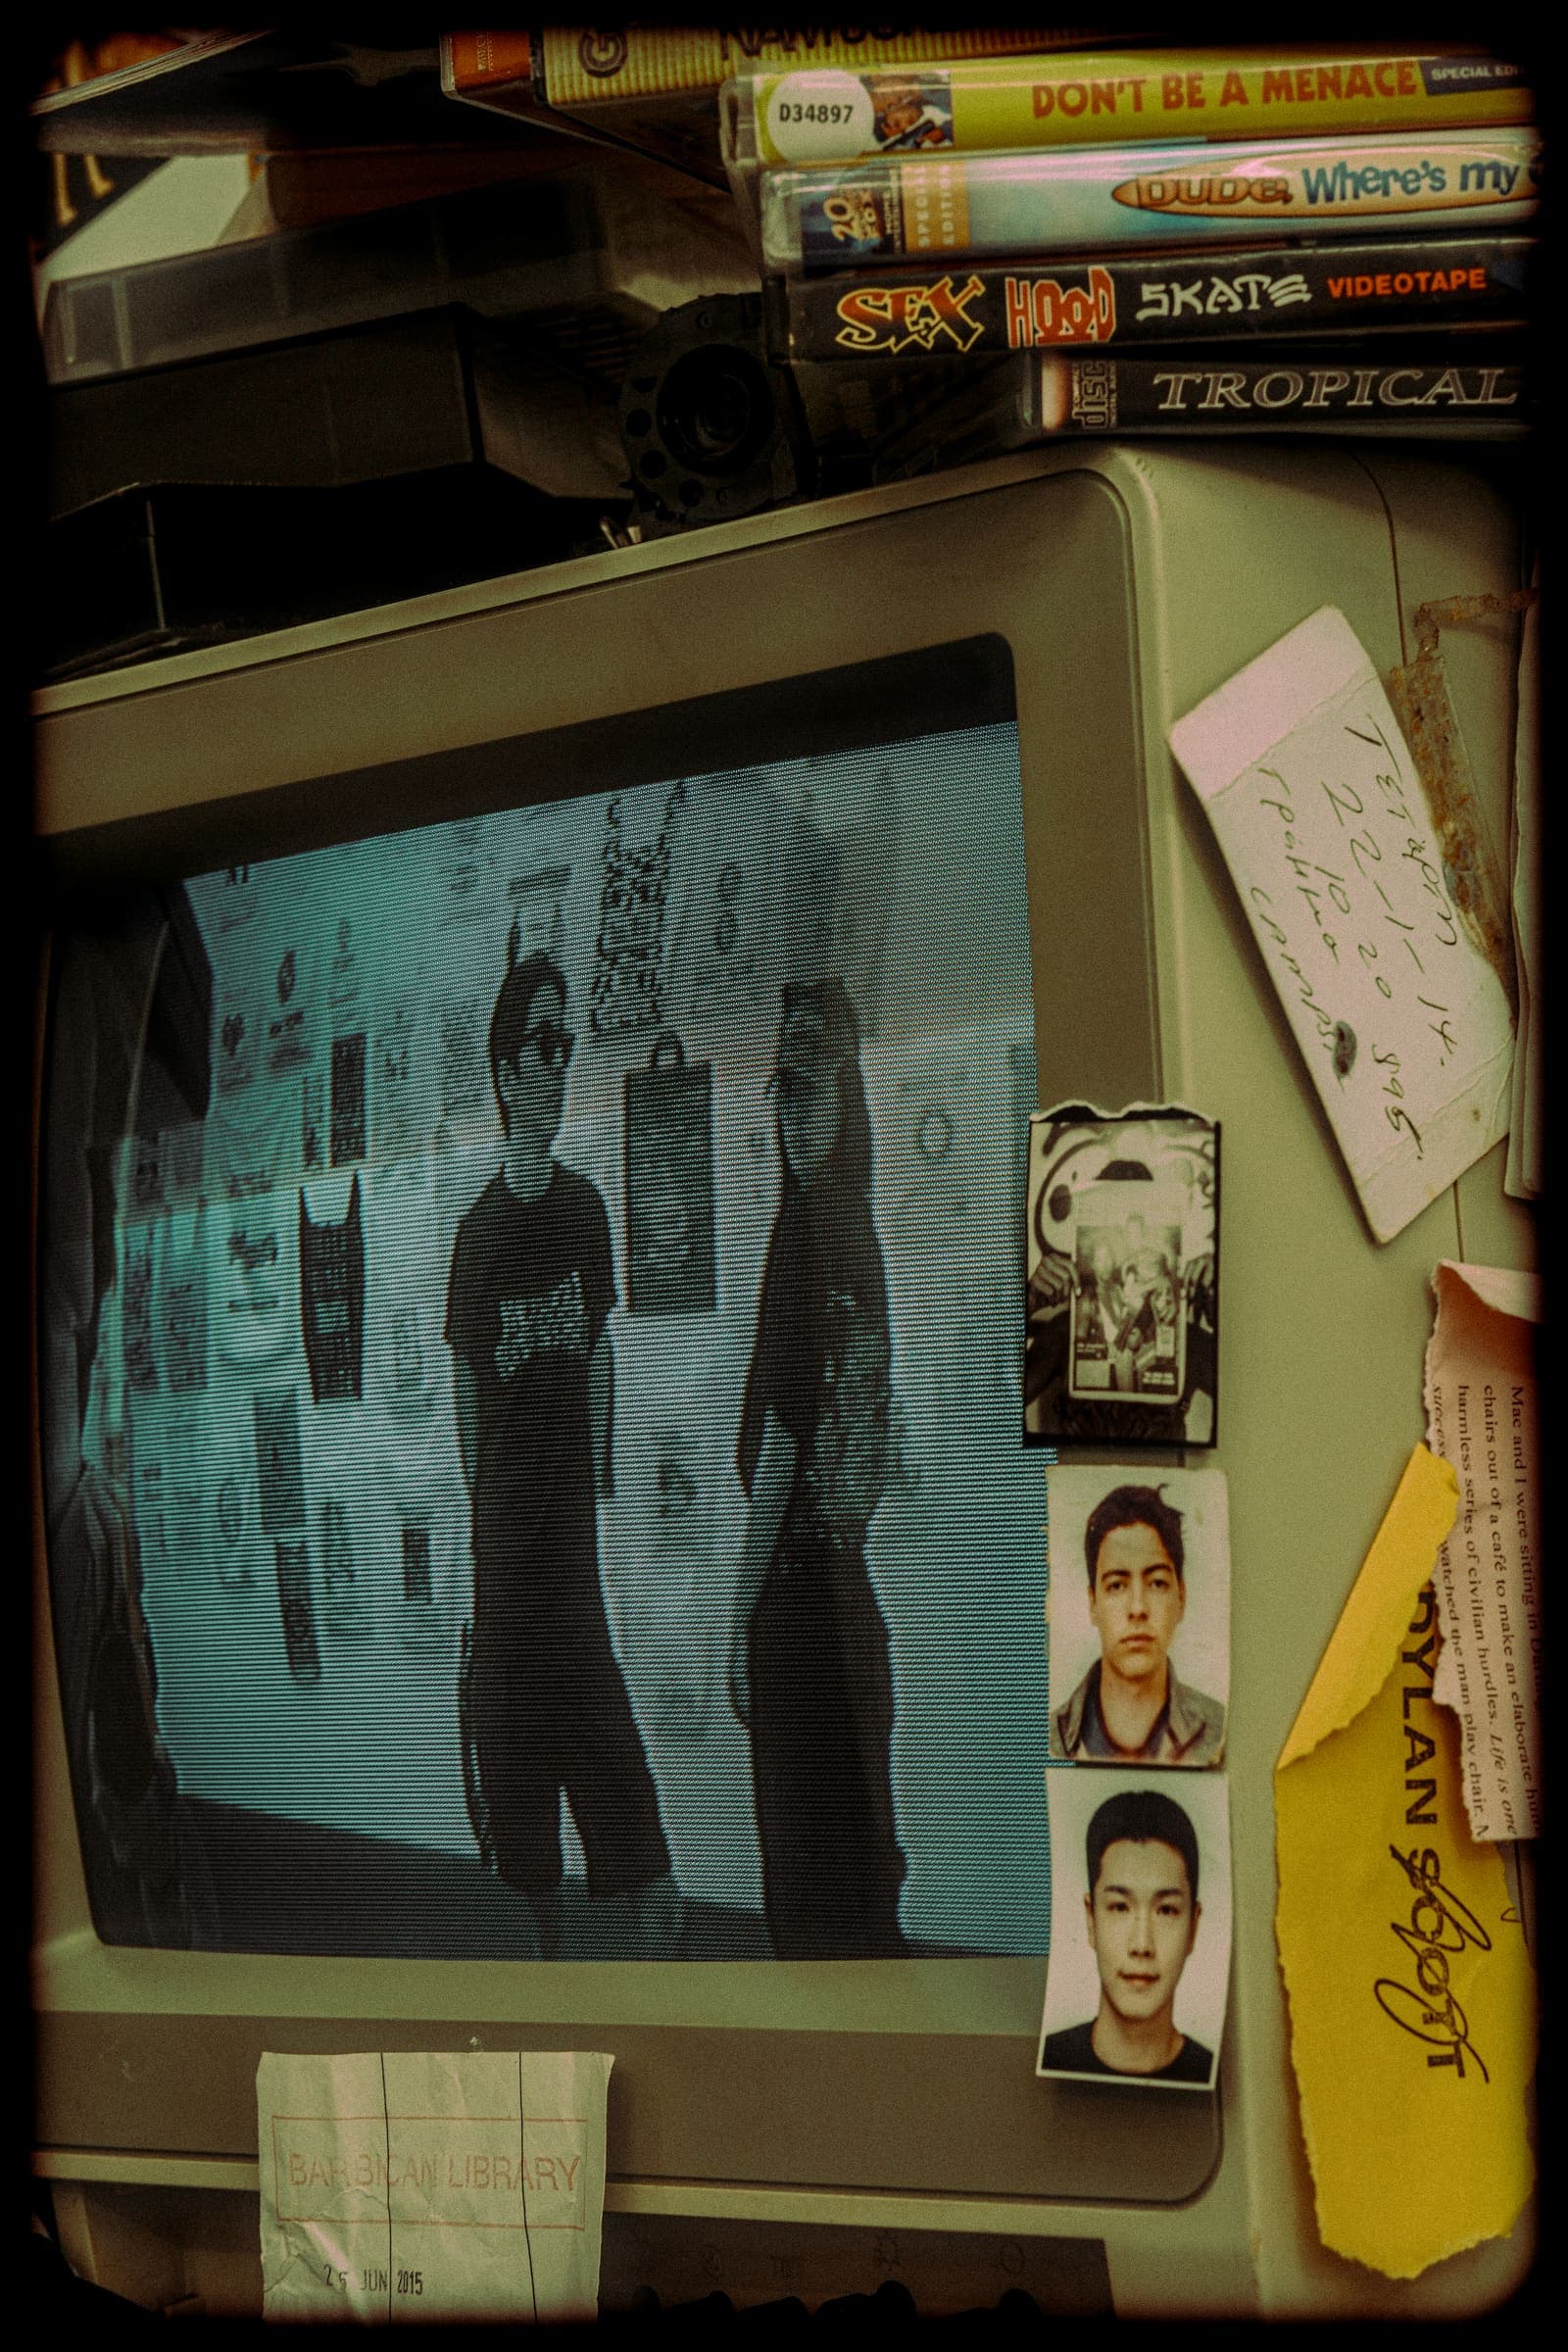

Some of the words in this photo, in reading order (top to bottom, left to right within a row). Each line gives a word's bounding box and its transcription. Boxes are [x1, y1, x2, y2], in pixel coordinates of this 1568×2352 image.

[1032, 77, 1147, 118] DON'T
[1162, 73, 1206, 110] BE
[1219, 69, 1250, 107] A
[1261, 62, 1419, 104] MENACE
[1430, 65, 1494, 81] SPECIAL
[778, 104, 855, 125] D34897
[1302, 160, 1446, 204] Where's
[1459, 161, 1520, 196] my
[1134, 273, 1312, 321] SKATE
[1325, 266, 1488, 300] VIDEOTAPE
[835, 274, 987, 356] SEX
[1004, 266, 1117, 347] HOOD
[1152, 367, 1520, 411] TROPICAL
[1457, 1385, 1472, 1471] harmless
[1484, 1385, 1497, 1444] chairs
[1510, 1386, 1524, 1428] Mac
[1487, 1449, 1498, 1482] out
[1512, 1435, 1527, 1469] and
[1464, 1477, 1477, 1535] series
[1489, 1514, 1498, 1524] a
[1490, 1488, 1502, 1510] of
[1515, 1491, 1529, 1538] were
[1466, 1541, 1480, 1564] of
[1492, 1531, 1507, 1572] café
[1494, 1579, 1506, 1597] to
[1520, 1544, 1536, 1606] sitting
[1468, 1567, 1485, 1641] civilian
[1528, 1612, 1542, 1630] in
[1450, 1629, 1463, 1656] the
[1498, 1604, 1515, 1656] make
[1456, 1663, 1471, 1706] man
[1477, 1647, 1498, 1725] hurdles.
[1505, 1662, 1517, 1685] an
[1464, 1713, 1478, 1756] play
[1490, 1733, 1506, 1771] Life
[1511, 1690, 1533, 1783] elaborate
[1468, 1761, 1488, 1817] chair.
[1497, 1777, 1510, 1794] is
[1500, 1798, 1518, 1836] one
[1408, 1847, 1467, 2080] SCOTT
[289, 2153, 438, 2190] BARBICAN
[448, 2154, 581, 2191] LIBRARY
[359, 2268, 389, 2292] JUN
[397, 2269, 424, 2295] 2015
